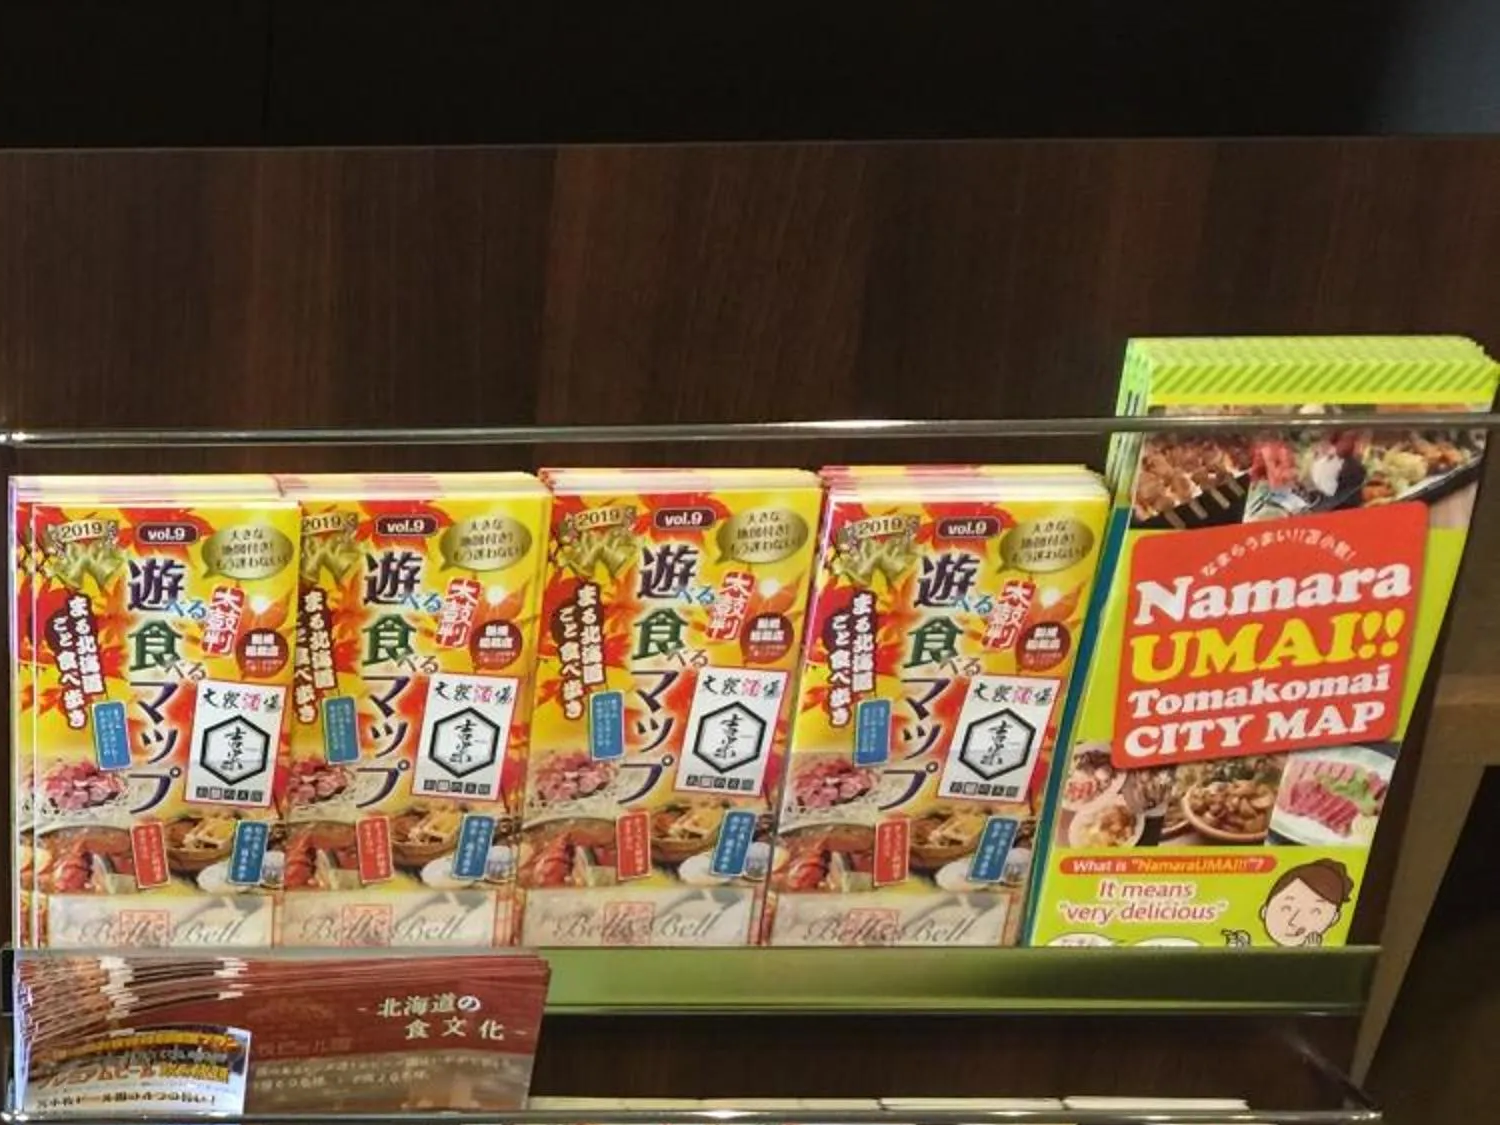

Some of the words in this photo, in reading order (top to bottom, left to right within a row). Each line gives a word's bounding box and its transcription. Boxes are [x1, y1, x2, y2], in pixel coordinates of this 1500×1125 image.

[301, 517, 342, 531] 2019
[577, 510, 621, 525] 2019
[664, 511, 703, 526] vol.9
[62, 524, 102, 539] 2019
[146, 526, 186, 541] vol.9
[386, 519, 425, 534] vol.9
[857, 519, 900, 535] 2019
[947, 522, 987, 536] vol.9
[1133, 563, 1412, 626] Namara
[1130, 608, 1405, 683] UMAI!!
[1128, 664, 1392, 718] Tomakomai
[1124, 713, 1254, 757] CITY
[1263, 701, 1385, 743] MAP
[1073, 860, 1111, 873] What
[1116, 860, 1127, 871] is
[1099, 880, 1114, 898] It
[1121, 882, 1193, 898] means
[377, 993, 481, 1018] 北海道の
[405, 1017, 504, 1040] 食文化
